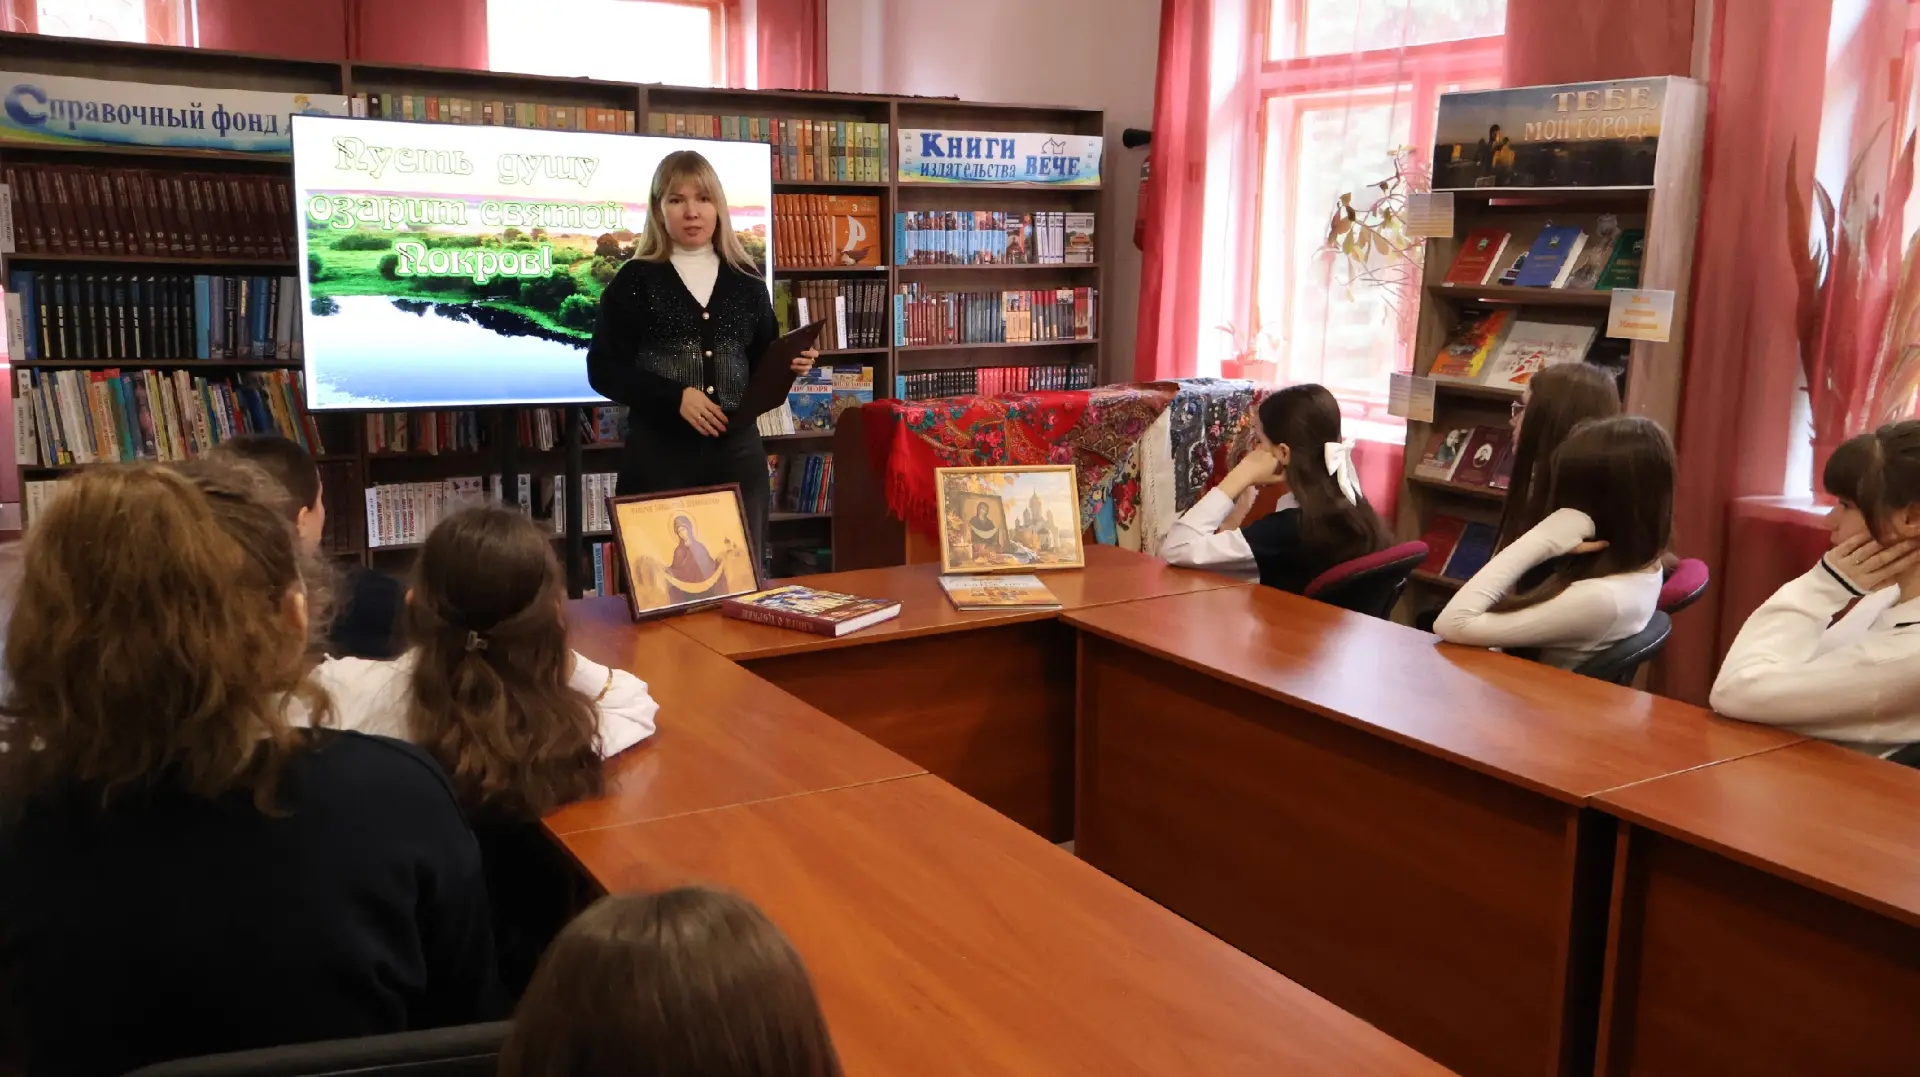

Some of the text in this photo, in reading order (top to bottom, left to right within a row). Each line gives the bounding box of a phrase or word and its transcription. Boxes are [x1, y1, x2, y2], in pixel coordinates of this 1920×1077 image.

[4, 84, 206, 130] Справочный
[212, 103, 279, 137] фонд
[1525, 115, 1571, 141] МОЙ
[333, 136, 600, 187] Пусть душу
[920, 154, 1081, 179] издательства ВЕЧЕ
[308, 195, 624, 231] озарит святой
[852, 204, 858, 212] 3
[395, 242, 551, 283] Покров!
